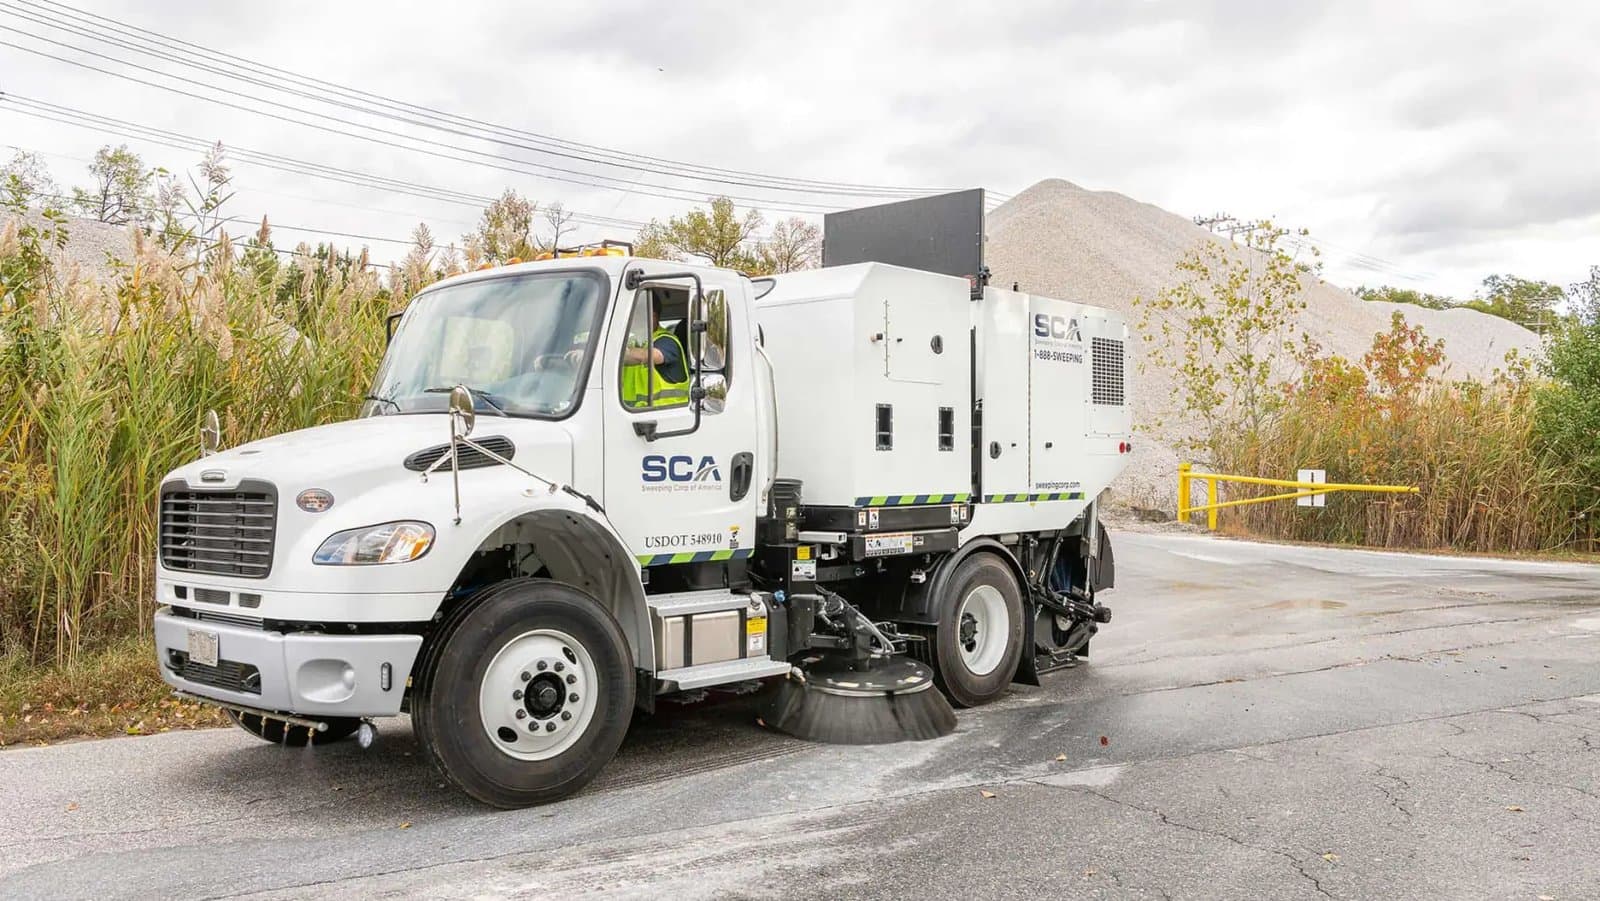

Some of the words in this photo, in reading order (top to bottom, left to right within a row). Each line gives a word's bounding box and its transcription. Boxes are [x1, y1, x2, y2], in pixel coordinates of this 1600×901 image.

[1035, 313, 1082, 342] SCA
[1034, 349, 1083, 364] 1-888-SWEEPING
[642, 455, 722, 482] SCA
[641, 484, 672, 493] Sweeping
[673, 484, 689, 492] Corp
[1035, 481, 1081, 490] sweepingcorp.com
[645, 534, 689, 548] USDOT
[690, 533, 722, 546] 548910
